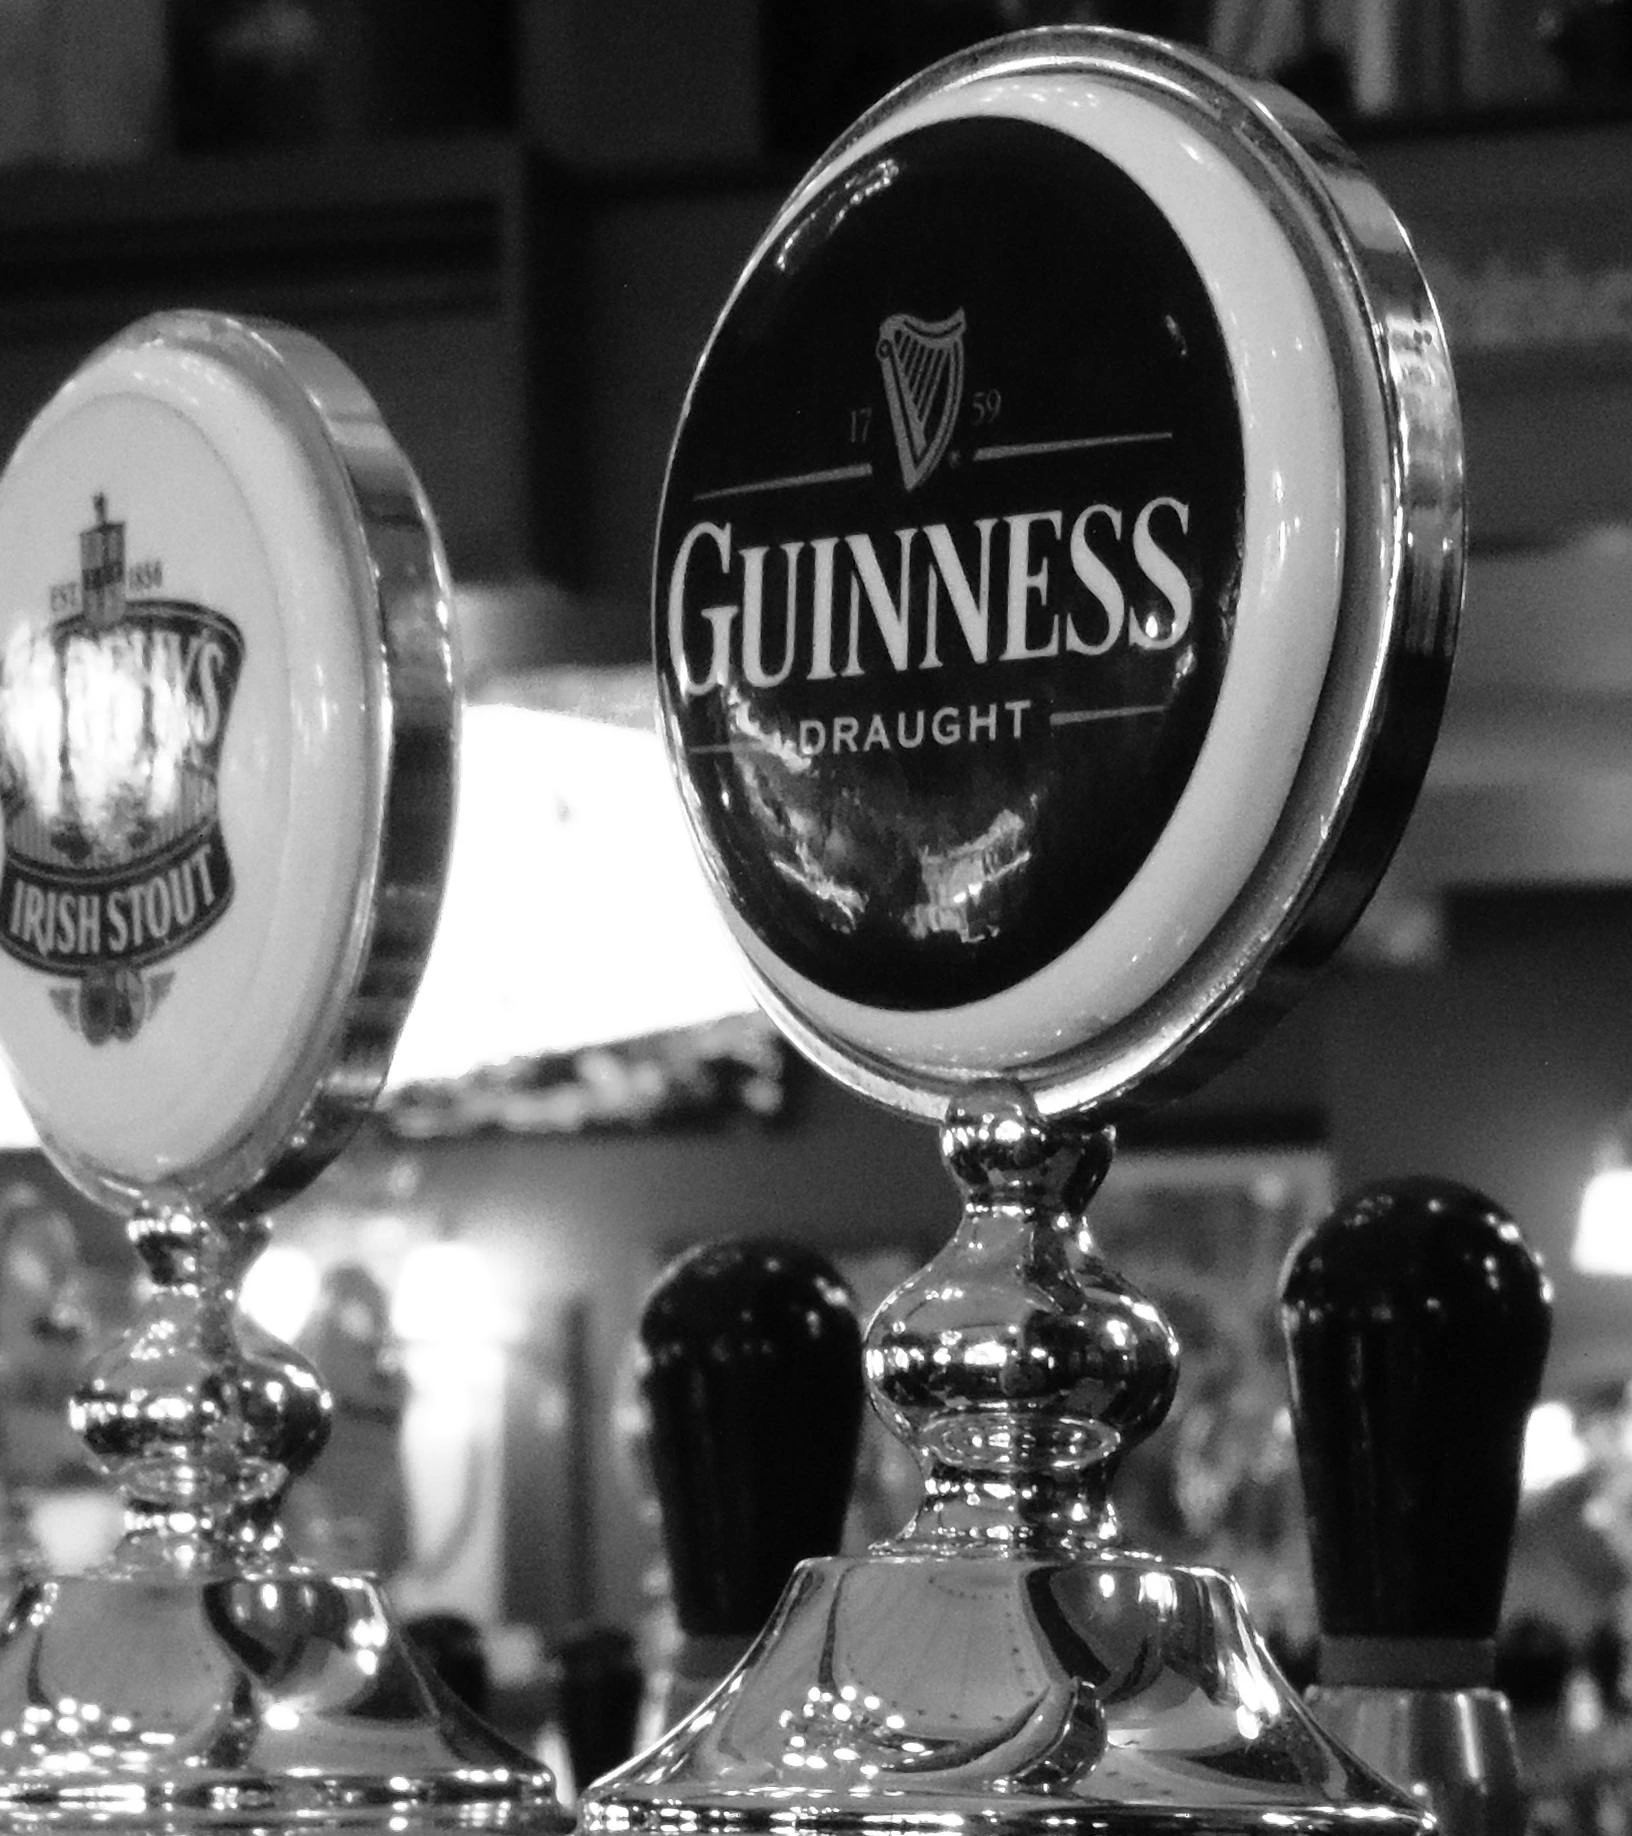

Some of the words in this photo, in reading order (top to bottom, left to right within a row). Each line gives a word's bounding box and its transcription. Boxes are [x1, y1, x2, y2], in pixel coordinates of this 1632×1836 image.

[850, 407, 873, 443] 17
[970, 388, 1002, 427] 59
[668, 496, 1193, 699] GUINNESS
[799, 699, 1031, 756] DRAUGHT
[9, 879, 101, 957] IRISH
[107, 844, 217, 955] STOUT
